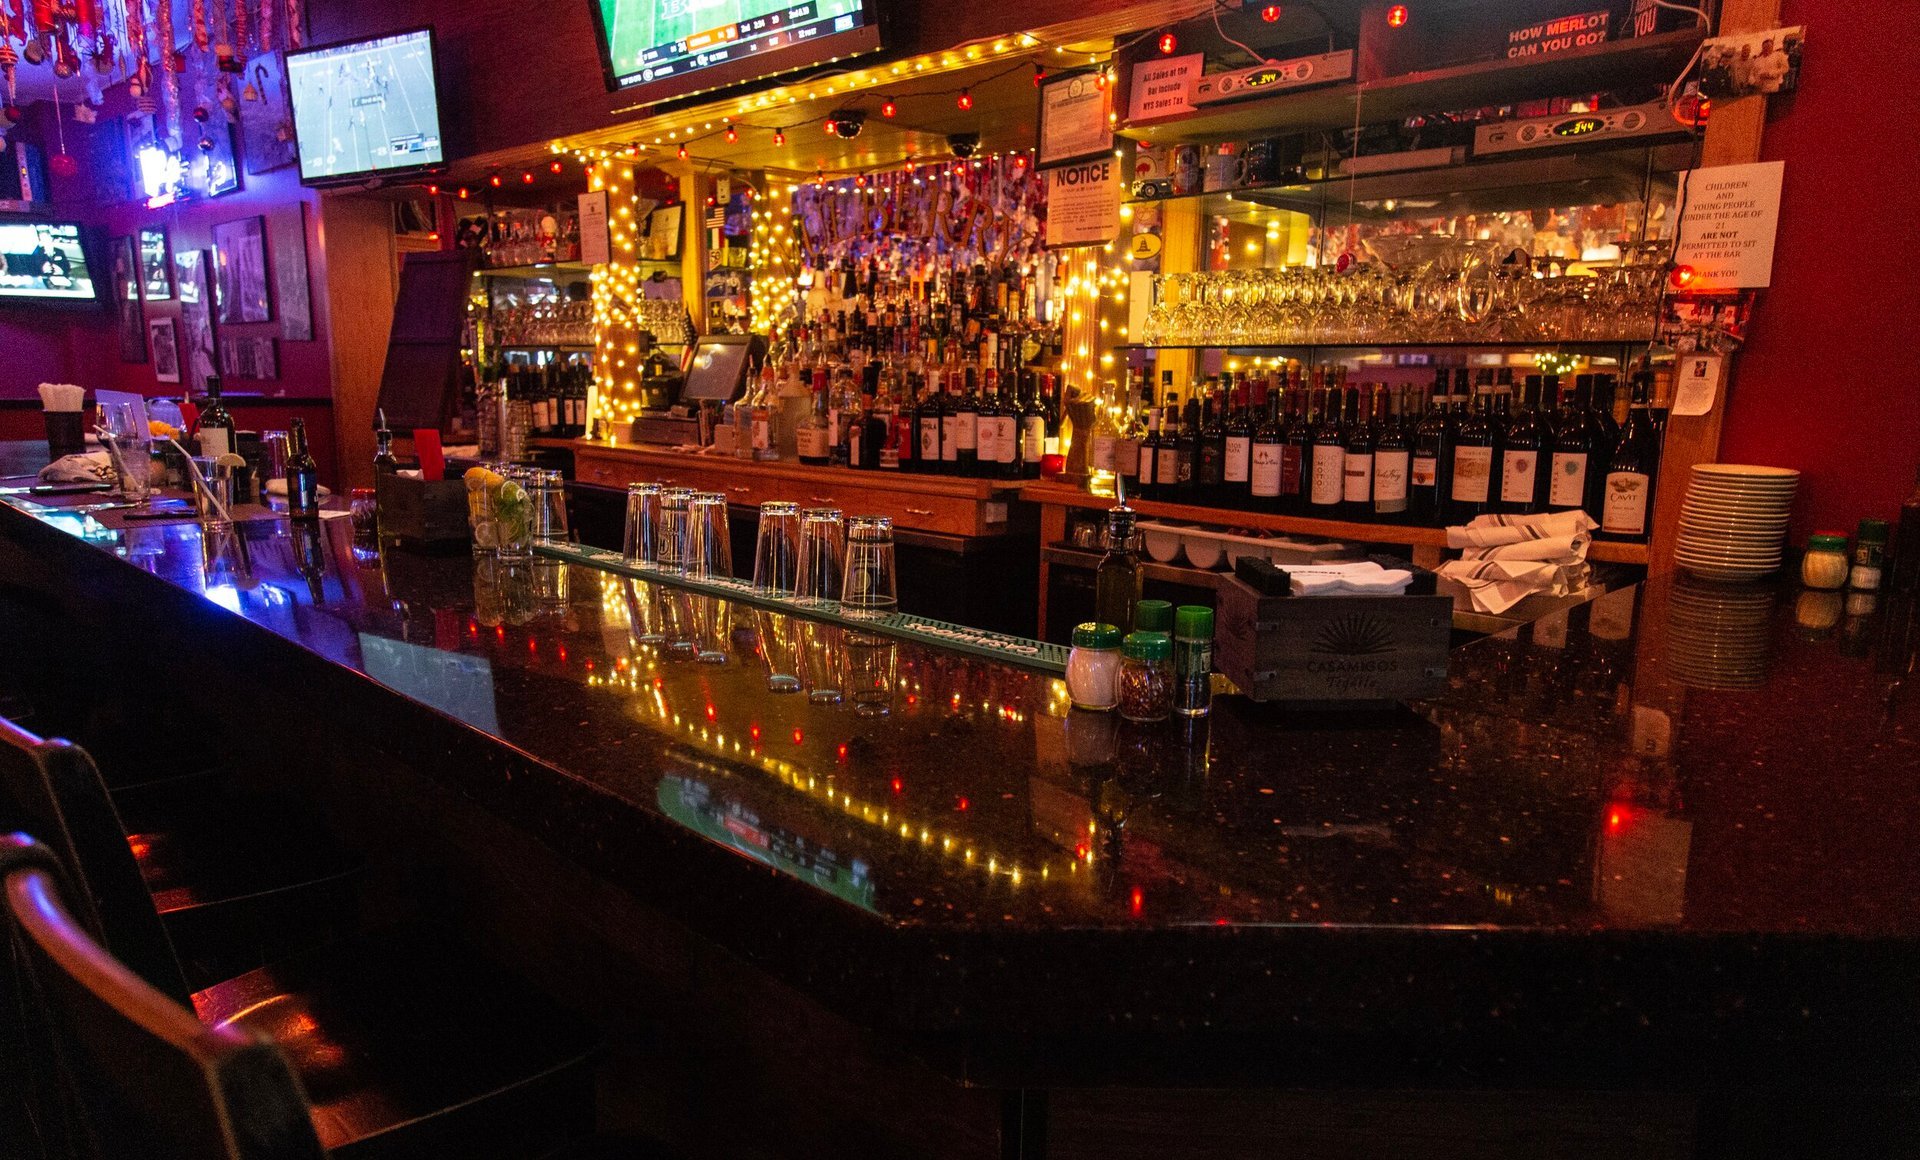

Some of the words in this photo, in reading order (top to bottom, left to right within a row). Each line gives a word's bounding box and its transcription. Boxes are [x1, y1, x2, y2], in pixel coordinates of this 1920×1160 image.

[1635, 6, 1657, 38] YOU
[1509, 26, 1543, 43] HOW
[1546, 13, 1609, 36] MERLOT
[1507, 43, 1538, 58] CAN
[1541, 37, 1571, 53] YOU
[1575, 31, 1607, 47] GO?
[1144, 74, 1152, 82] All
[1152, 71, 1169, 80] Sales
[1170, 69, 1177, 77] at
[1178, 67, 1188, 75] the
[1148, 87, 1158, 95] Bar
[1143, 102, 1154, 110] NYS
[1155, 98, 1172, 107] Sales
[1173, 97, 1184, 105] Tax
[1056, 163, 1109, 187] NOTICE
[1705, 181, 1748, 191] CHILDREN
[1715, 192, 1734, 200] AND
[1694, 202, 1721, 211] YOUNG
[1723, 200, 1756, 210] PEOPLE
[1684, 213, 1712, 221] UNDER
[1714, 212, 1731, 220] THE
[1732, 211, 1749, 219] AGE
[1751, 210, 1763, 218] OF
[1700, 232, 1718, 240] ARE
[1719, 231, 1739, 239] NOT
[1681, 242, 1728, 250] PERMITTED
[1730, 241, 1741, 249] TO
[1743, 240, 1757, 248] SIT
[1705, 251, 1723, 259] THE
[1610, 493, 1637, 503] CAVIT
[1307, 660, 1398, 673] CASAMIGOS
